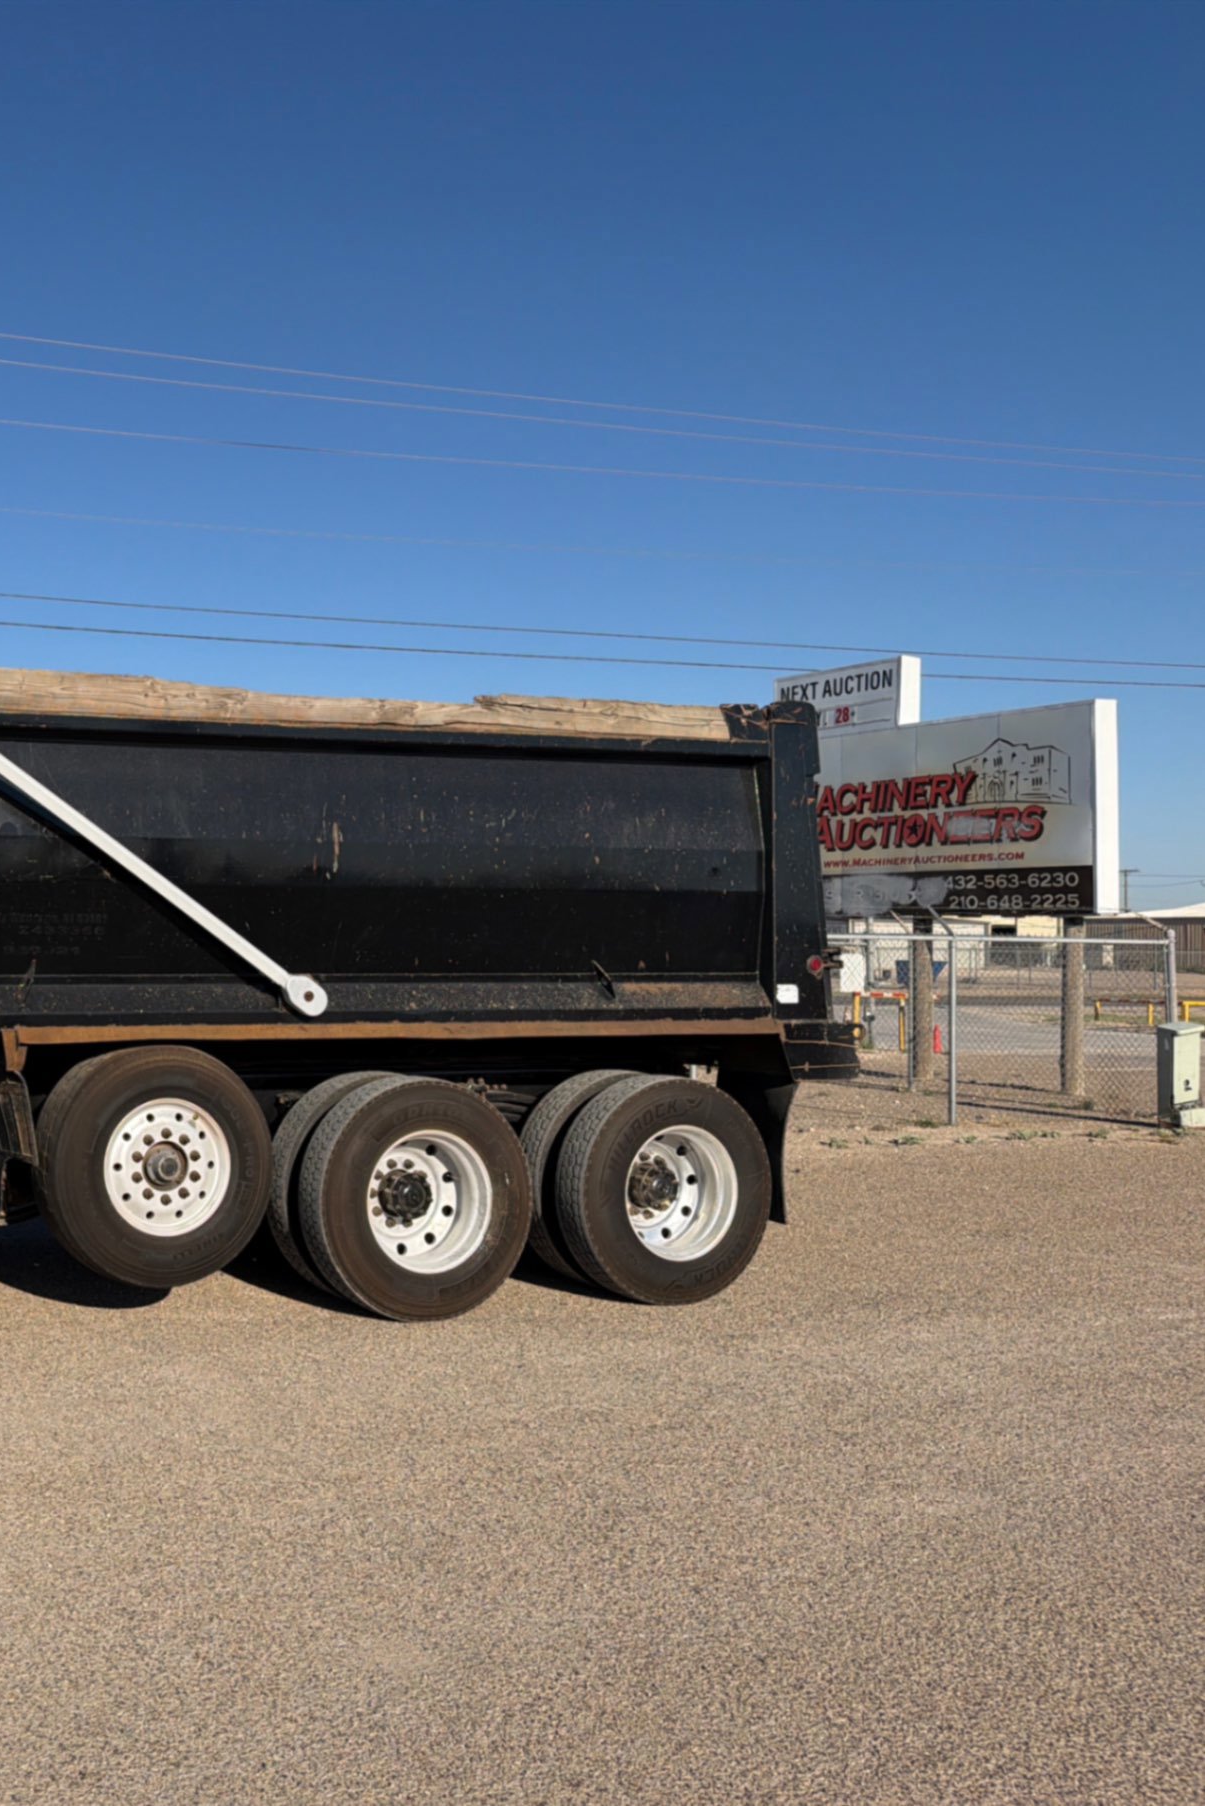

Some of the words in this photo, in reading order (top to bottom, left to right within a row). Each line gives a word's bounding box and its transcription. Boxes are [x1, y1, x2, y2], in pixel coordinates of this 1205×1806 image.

[780, 682, 819, 702] NEXT
[822, 669, 893, 699] AUCTION
[815, 770, 977, 817] ACHINERY
[945, 871, 1080, 890] 432-563-6230
[949, 893, 1081, 910] 210-648-2225
